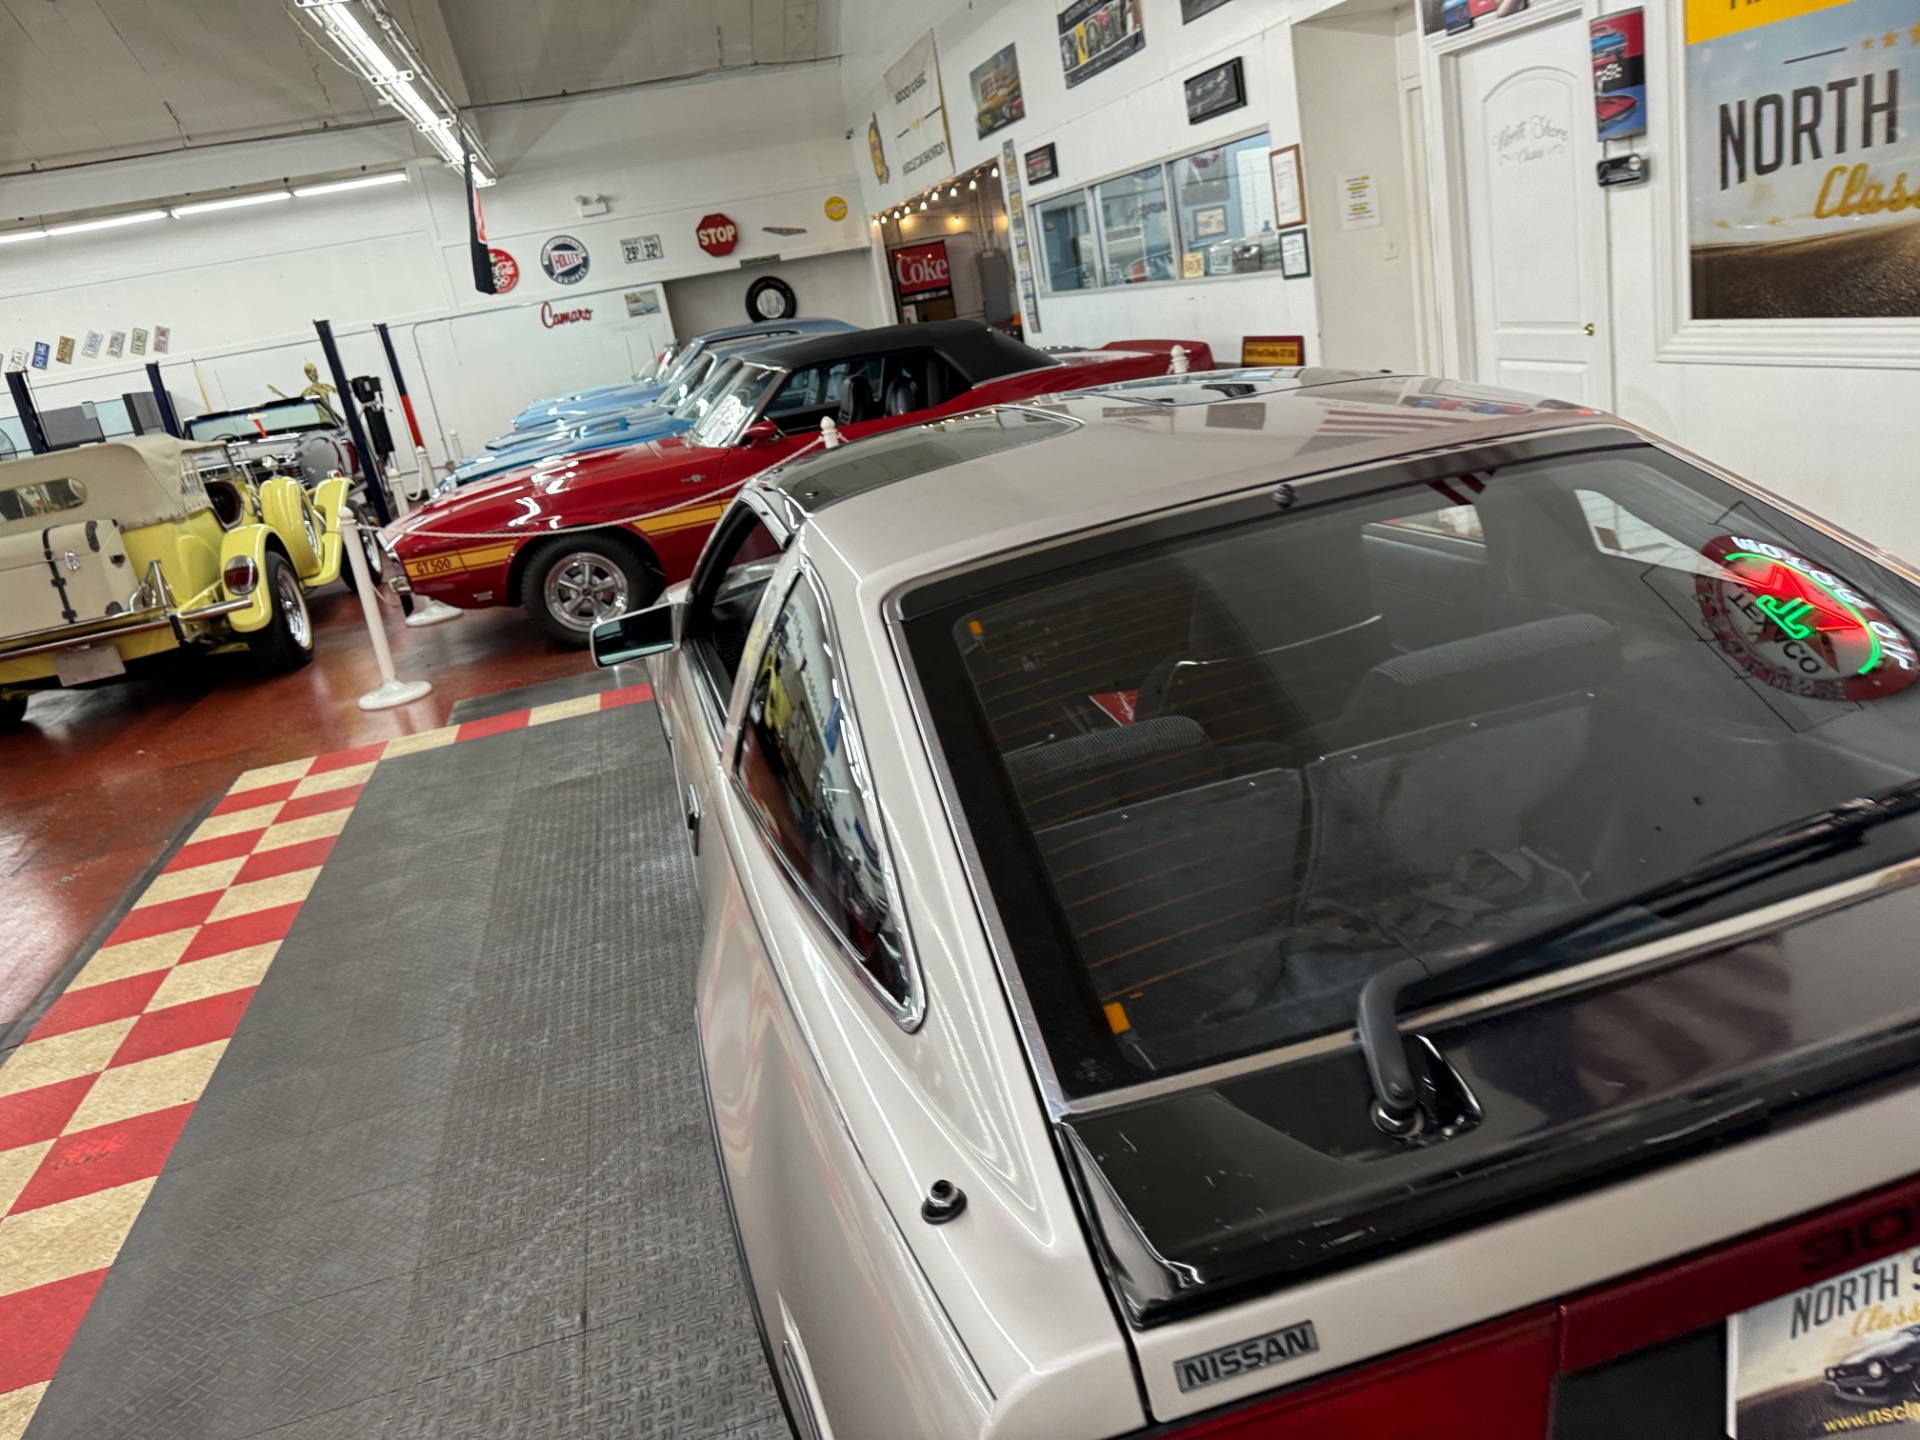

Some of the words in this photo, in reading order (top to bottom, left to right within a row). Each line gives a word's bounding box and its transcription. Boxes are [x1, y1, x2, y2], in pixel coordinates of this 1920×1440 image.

[1718, 68, 1899, 191] NORTH
[699, 224, 735, 247] STOP
[896, 256, 949, 286] Coke
[541, 301, 593, 328] Camaro
[417, 561, 429, 574] GT
[431, 558, 451, 571] 500
[1800, 1199, 1920, 1275] 30
[1790, 1262, 1899, 1340] NORTH
[1184, 1328, 1311, 1387] NISSAN
